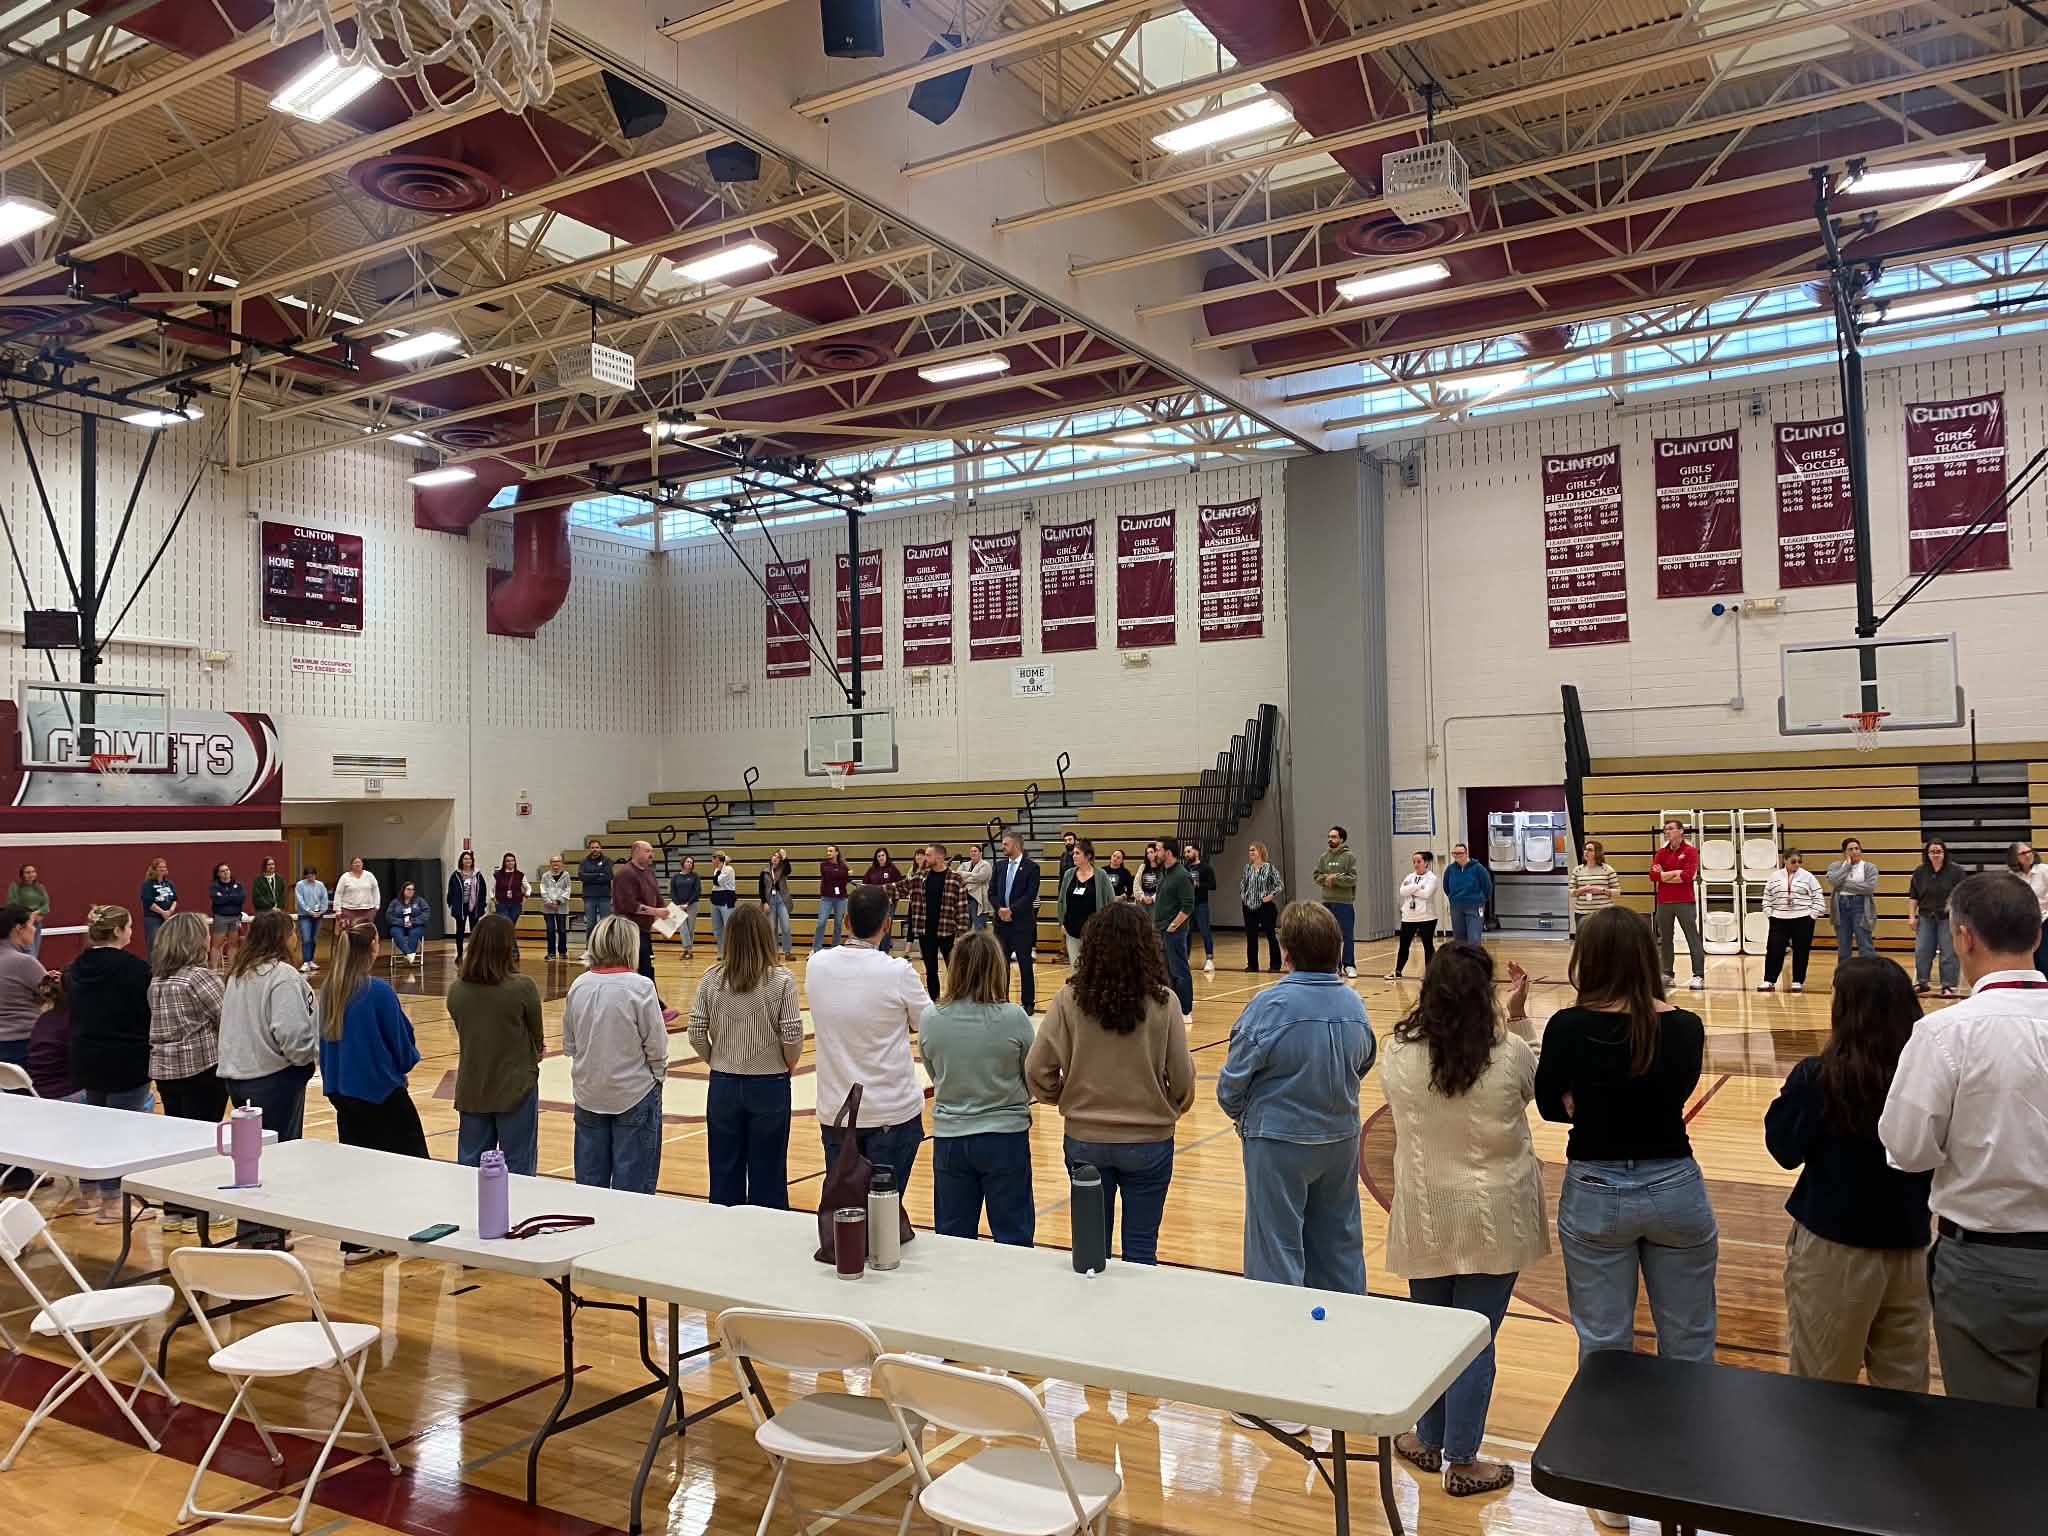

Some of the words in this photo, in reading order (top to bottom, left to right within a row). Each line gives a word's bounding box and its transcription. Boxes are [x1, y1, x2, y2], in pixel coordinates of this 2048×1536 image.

[1913, 400, 1996, 423] CLINTON
[1781, 423, 1845, 442] CLINTO
[1935, 429, 1976, 442] GIRLS'
[1661, 436, 1733, 457] CLINTON
[1934, 441, 1976, 453] TRACK
[1802, 448, 1840, 461] GIRLS'
[1548, 452, 1615, 473] CLINTON
[1798, 458, 1846, 471] SOCCER
[1977, 465, 2000, 473] 01-02
[1680, 464, 1715, 475] GIRLS'
[1682, 475, 1711, 485] GOLF
[1688, 481, 1736, 492] CHAMPIONSHIP
[1546, 492, 1574, 503] FIELD
[1577, 486, 1619, 499] HOCKEY
[1812, 486, 1832, 494] 92-93
[1201, 502, 1257, 521] CLINTON
[1812, 502, 1833, 510] 05-06
[1121, 516, 1170, 531] CLINTON
[294, 528, 334, 541] CLINTON
[1045, 525, 1092, 540] CLINTON
[1218, 527, 1243, 536] GIRLS'
[972, 536, 1016, 550] CLINTON
[1134, 538, 1158, 546] GIRLS'
[1205, 534, 1254, 547] BASKETBALL
[907, 546, 949, 560] CLINTON
[1057, 545, 1079, 555] GIRLS'
[1133, 546, 1160, 555] TENNIS
[840, 554, 878, 568] CLTON
[1043, 556, 1069, 564] INDOOR
[1071, 553, 1093, 561] TRACK
[268, 557, 294, 568] HOME
[332, 566, 359, 577] GUEST
[917, 566, 937, 574] GIRLS'
[976, 564, 1013, 573] VOLLEYBALL
[924, 572, 950, 581] COUNTRY
[1020, 669, 1044, 678] HOME
